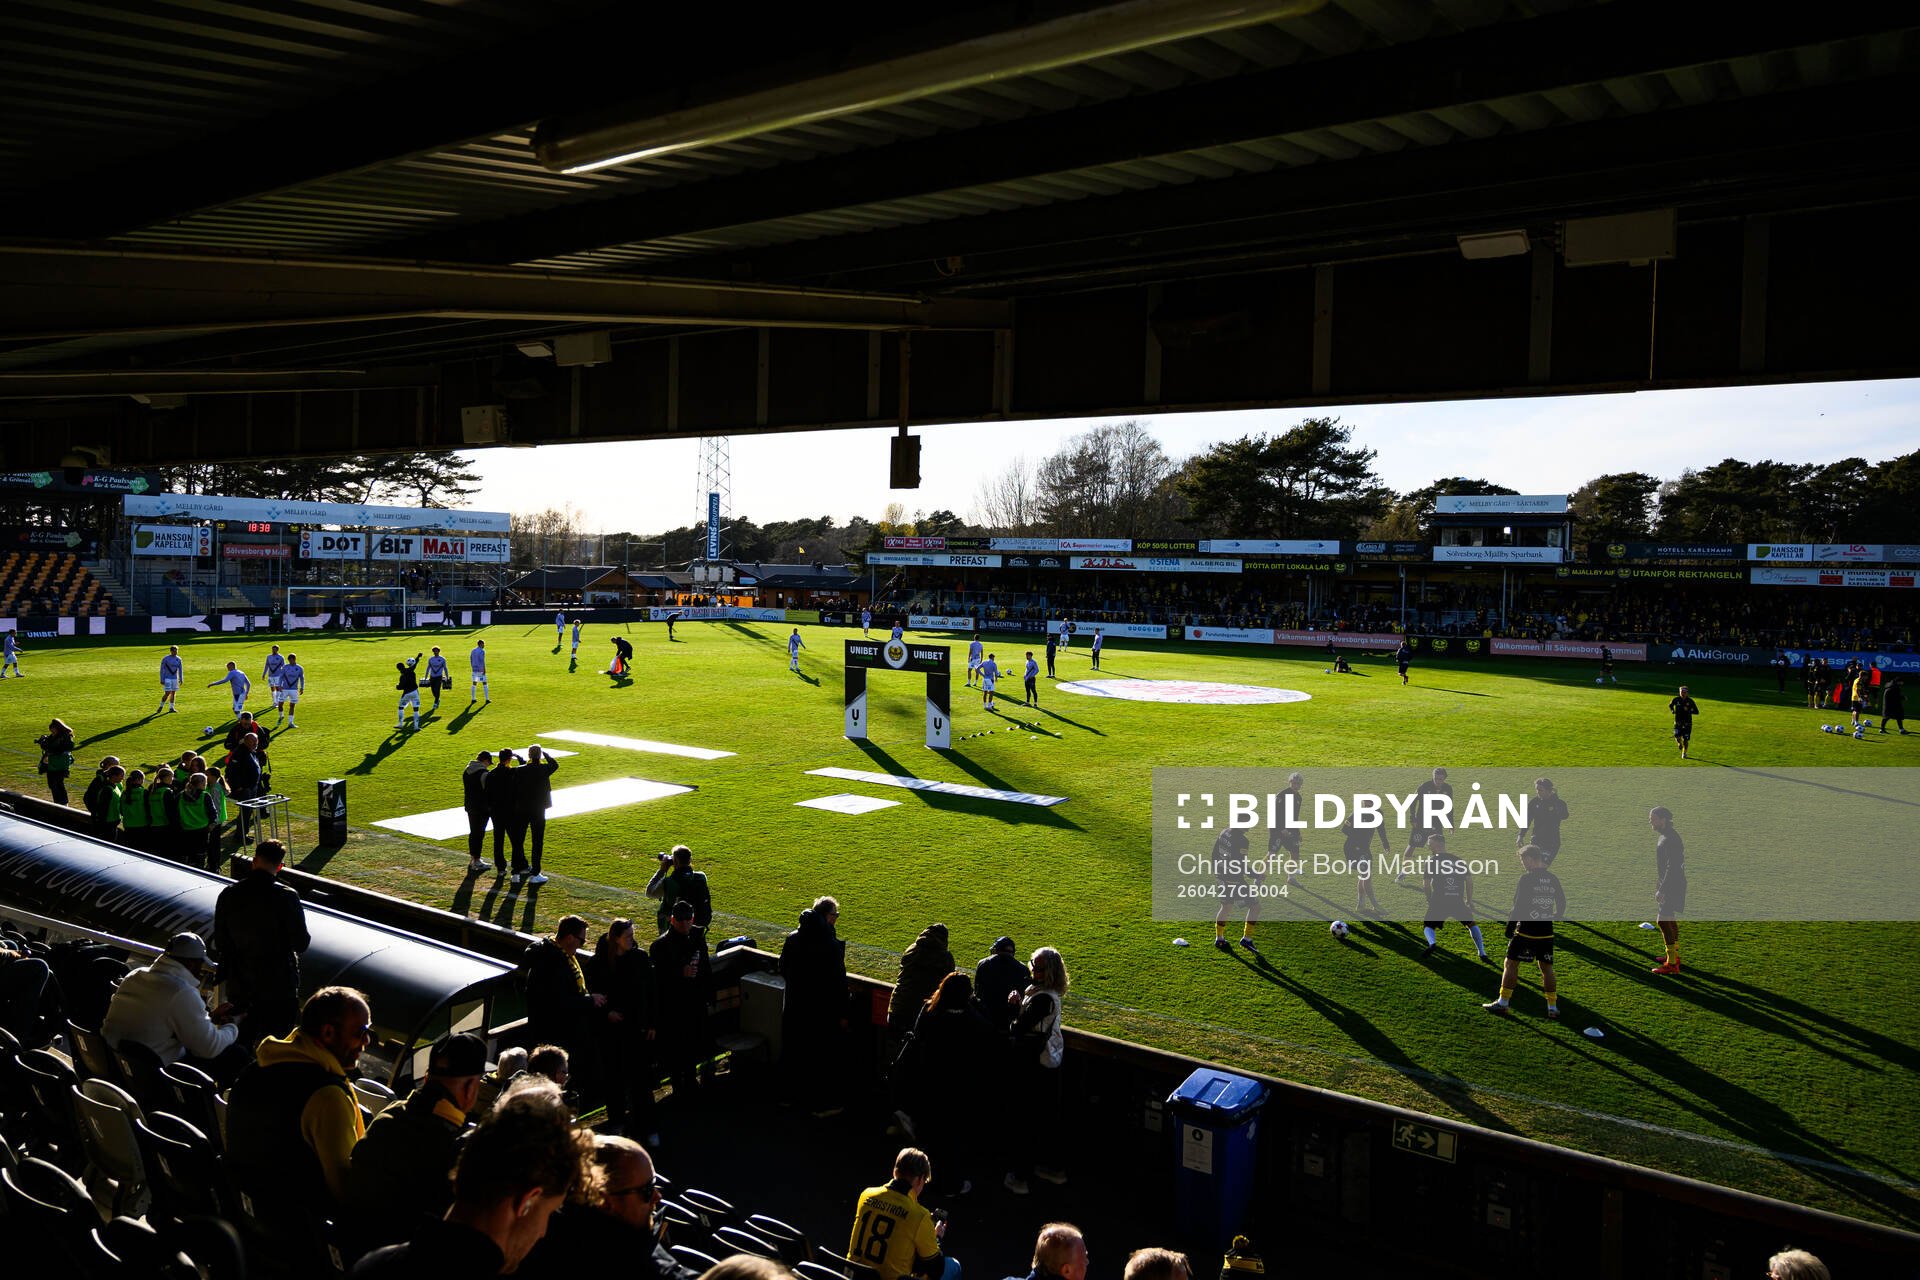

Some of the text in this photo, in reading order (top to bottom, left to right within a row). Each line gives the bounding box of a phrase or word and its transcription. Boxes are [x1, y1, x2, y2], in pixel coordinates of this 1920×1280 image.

[247, 523, 271, 533] 18:38
[156, 534, 192, 542] HANSSON
[155, 541, 181, 549] KAPELL
[470, 543, 507, 553] PREFAST
[1850, 544, 1866, 552] ICA
[1511, 551, 1543, 560] Sparbank
[950, 556, 987, 565] PREFAST
[1632, 569, 1742, 579] UTANFÖR REKTANGELN
[1277, 633, 1314, 642] Välkommen
[850, 646, 878, 655] UNIBET
[1494, 642, 1539, 650] Välkommen
[913, 650, 944, 660] UNIBET
[1688, 650, 1750, 663] AlviGroup
[852, 709, 859, 720] U
[934, 718, 942, 730] U
[852, 1210, 895, 1264] 18
